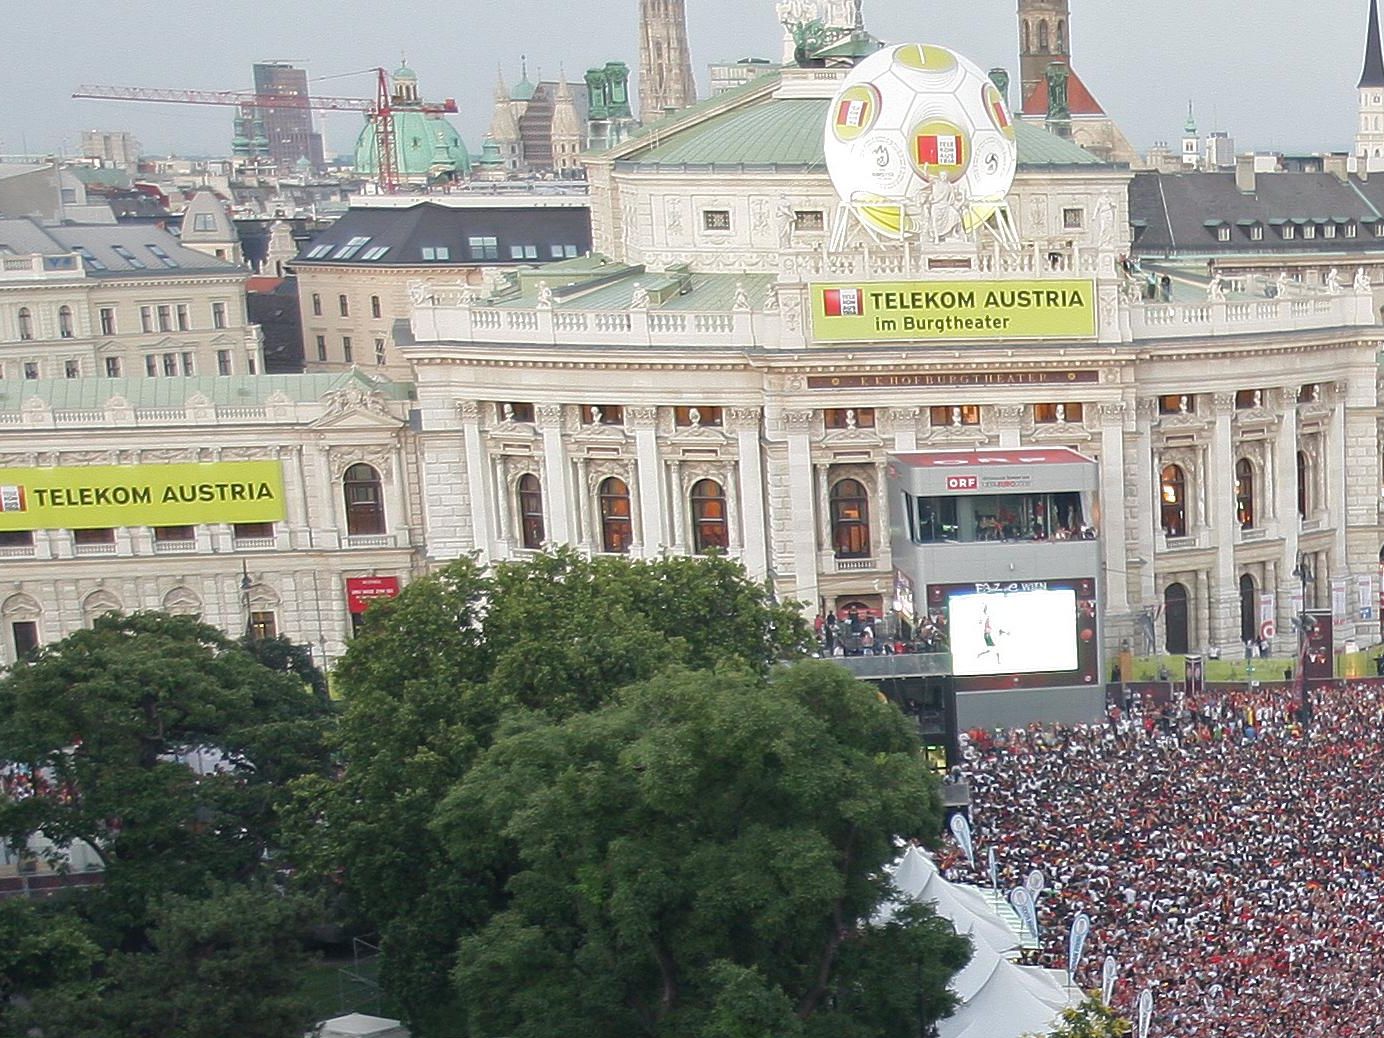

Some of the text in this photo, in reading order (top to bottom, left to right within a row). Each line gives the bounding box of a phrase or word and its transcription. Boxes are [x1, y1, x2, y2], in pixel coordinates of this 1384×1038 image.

[870, 291, 975, 310] TELEKOM
[985, 290, 1084, 308] AUSTRIA
[876, 315, 1010, 333] im Burgtheater
[949, 478, 976, 488] ORF
[34, 486, 151, 506] TELEKOM
[161, 482, 274, 503] AUSTRIA
